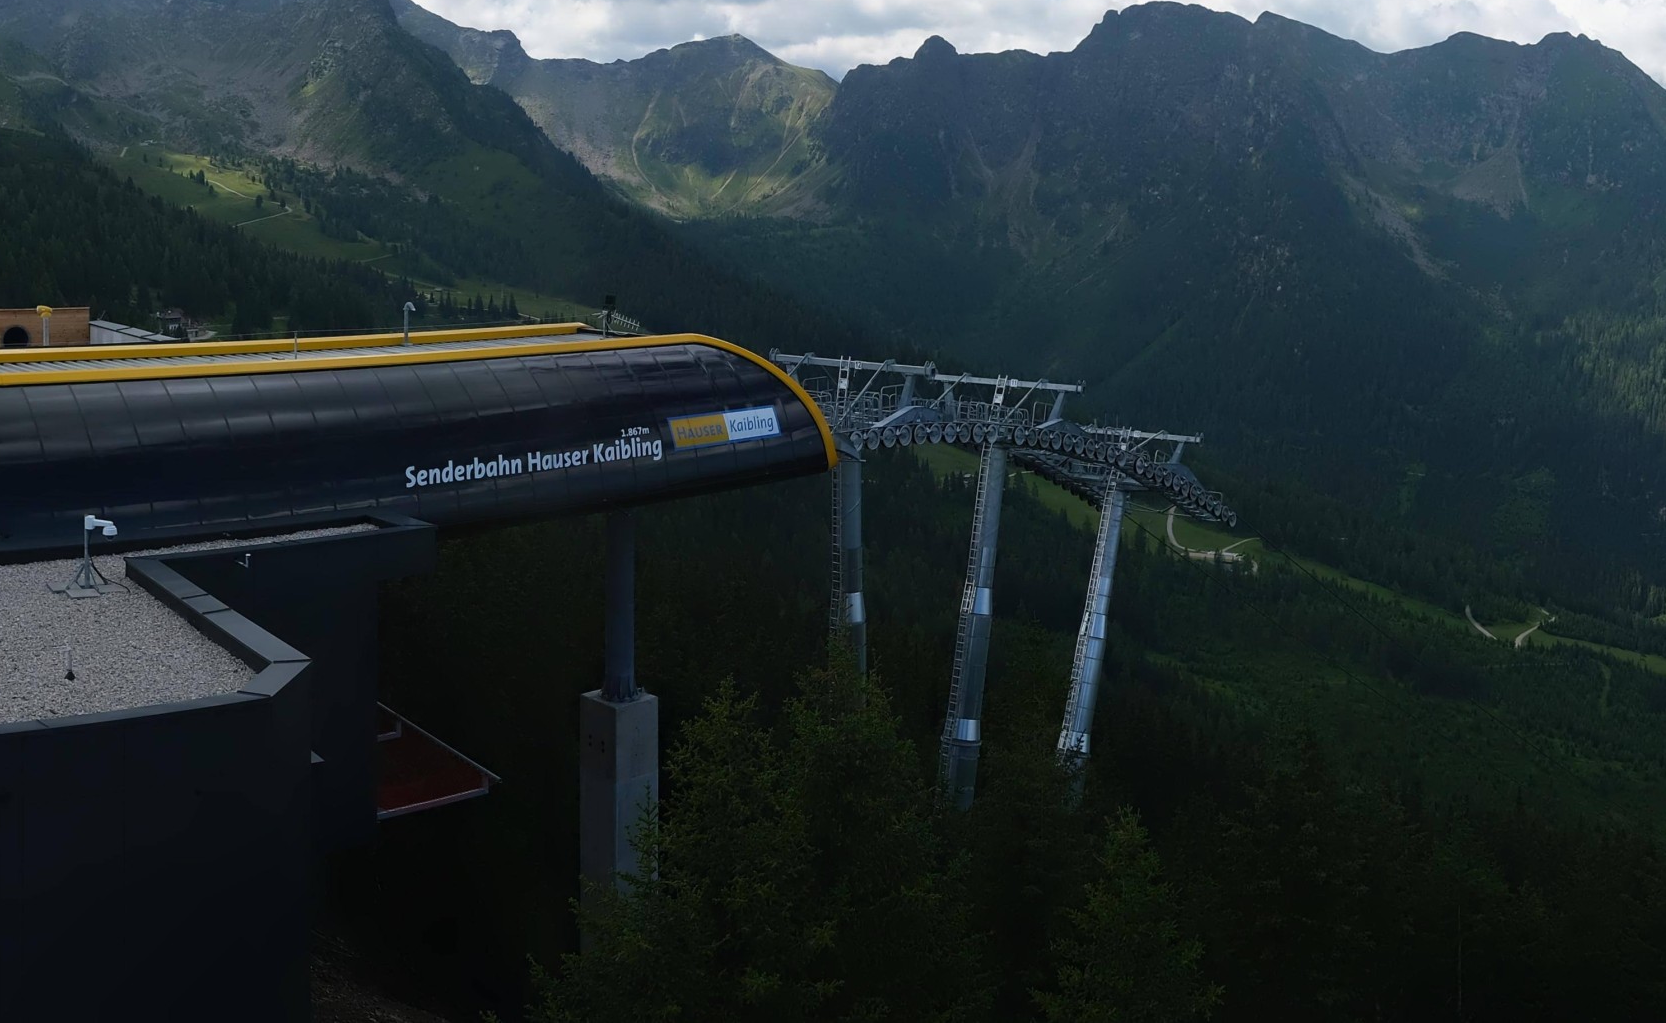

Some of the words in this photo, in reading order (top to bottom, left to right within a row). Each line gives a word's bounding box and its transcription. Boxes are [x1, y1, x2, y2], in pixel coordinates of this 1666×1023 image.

[621, 426, 650, 438] 1.867m
[677, 423, 724, 440] HAUSER
[729, 413, 775, 433] Kaibling
[405, 452, 522, 488] Senderbahn
[527, 448, 589, 472] Hauser
[593, 437, 663, 461] Kaibling
